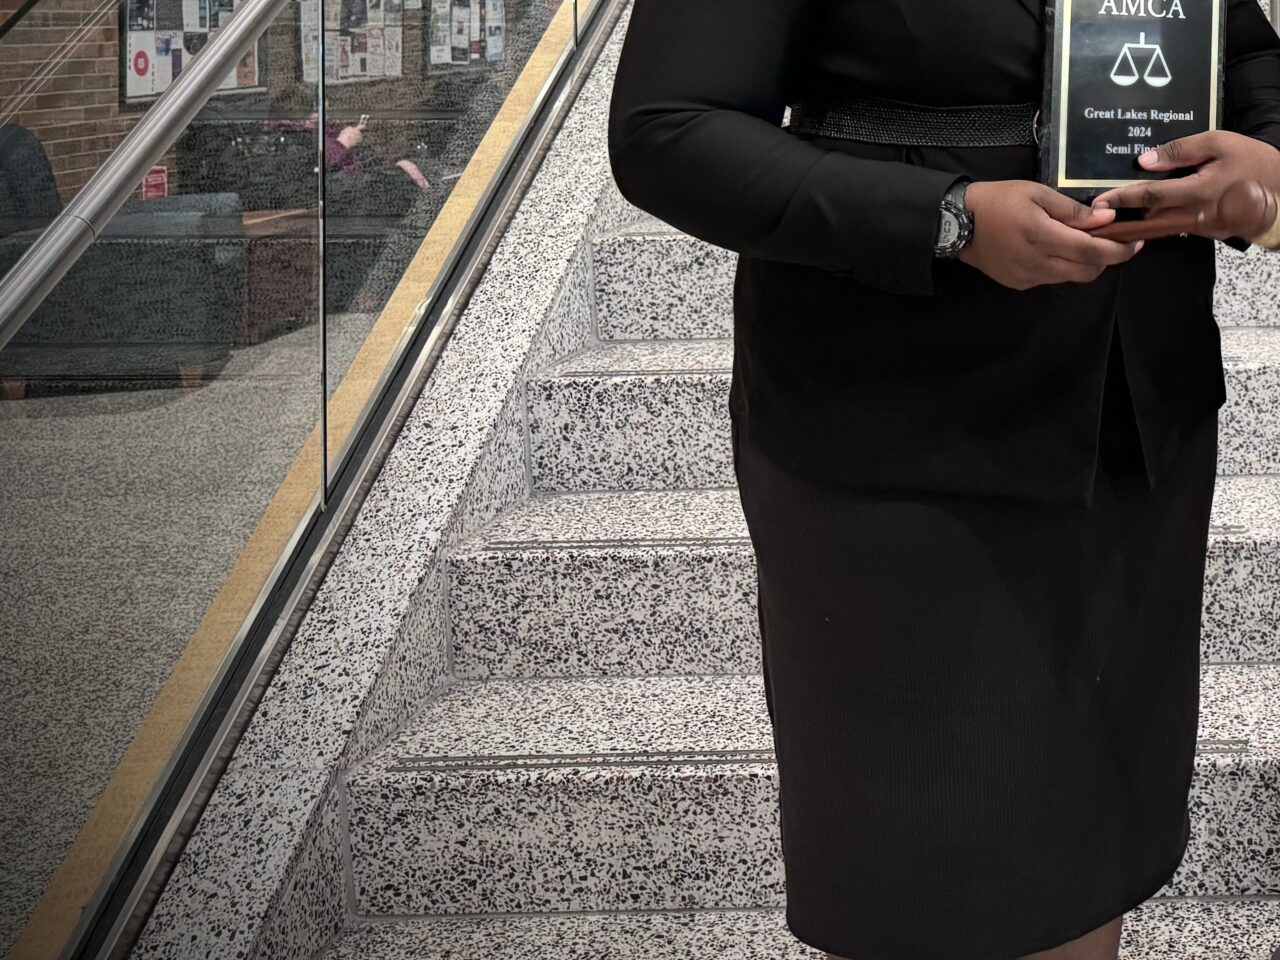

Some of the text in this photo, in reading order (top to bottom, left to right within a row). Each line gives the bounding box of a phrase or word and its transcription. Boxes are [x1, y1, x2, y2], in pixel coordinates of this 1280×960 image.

[1084, 107, 1194, 123] Great Lakes Regional
[1127, 126, 1152, 137] 2024
[1105, 143, 1131, 155] Semi
